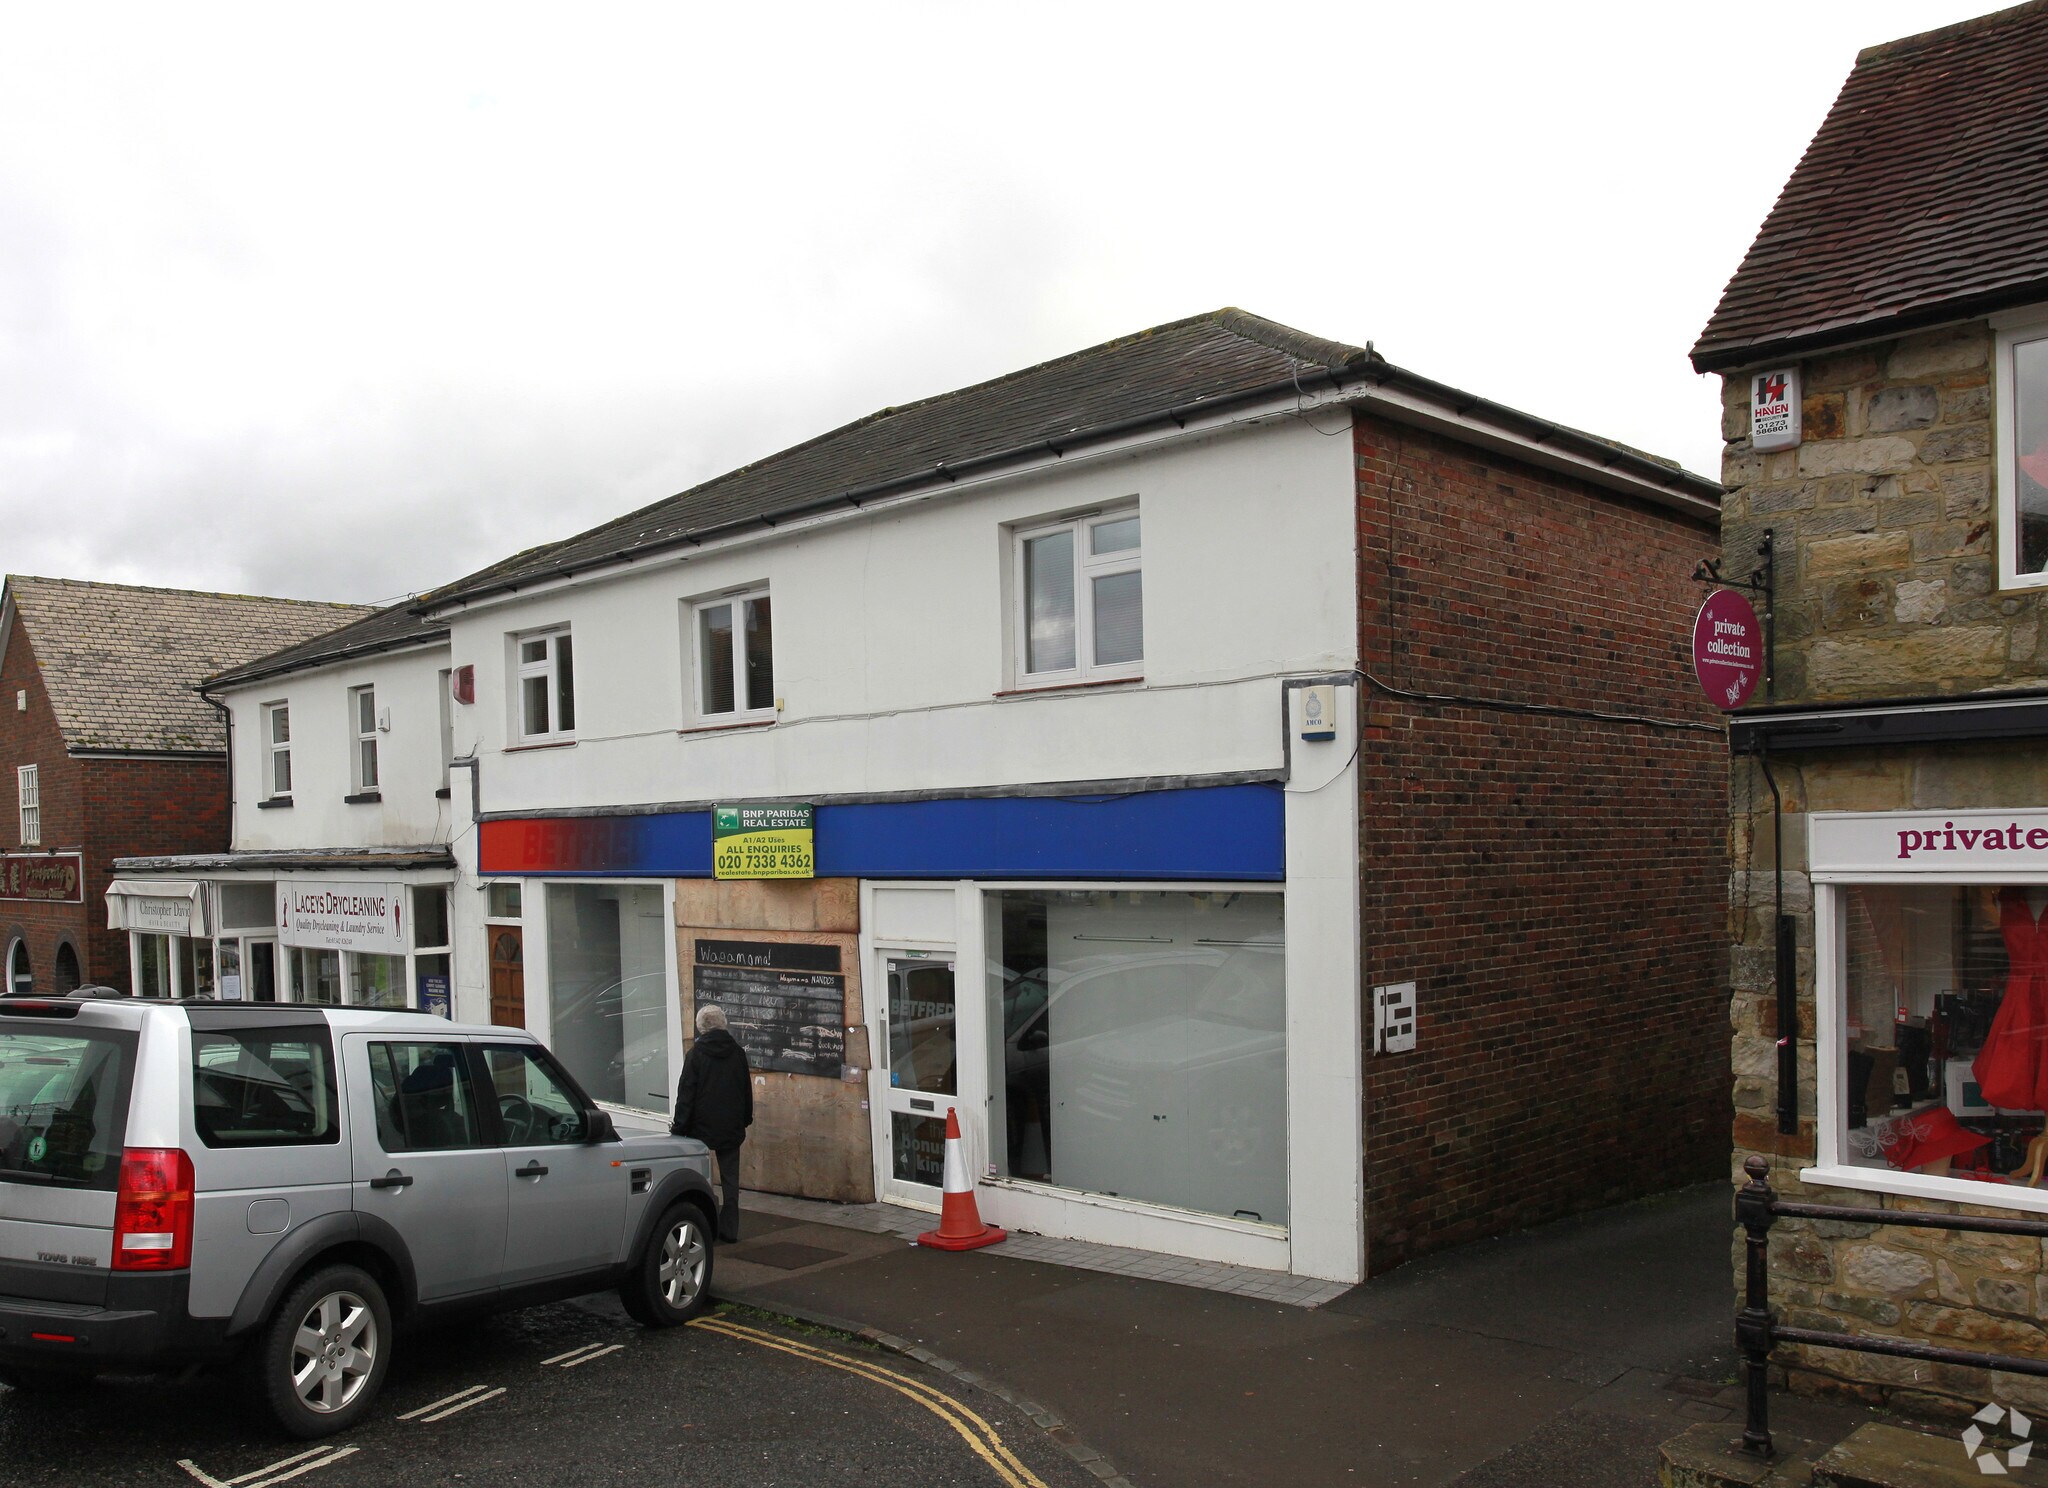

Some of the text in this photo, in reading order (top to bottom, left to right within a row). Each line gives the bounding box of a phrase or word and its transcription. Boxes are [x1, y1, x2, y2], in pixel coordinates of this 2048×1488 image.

[1755, 403, 1789, 417] HAVEN
[1758, 420, 1786, 429] 01273
[1761, 414, 1783, 422] SECURITY
[1755, 425, 1788, 435] 586801
[1714, 618, 1746, 636] private
[1707, 638, 1751, 658] collection
[742, 809, 810, 818] BNP PARIBAS
[743, 818, 807, 827] REAL ESTATE
[1897, 821, 2048, 859] private
[726, 845, 802, 854] ALL ENQUIRIES
[718, 854, 811, 869] 020 7338 4362
[140, 901, 191, 919] Christopher David
[294, 891, 386, 917] LACEYS DRYCLEANING
[296, 918, 385, 937] Quality Drycleaning & Laundry Service
[890, 998, 956, 1020] BETFRED
[37, 1252, 97, 1266] TDV6 HSE
